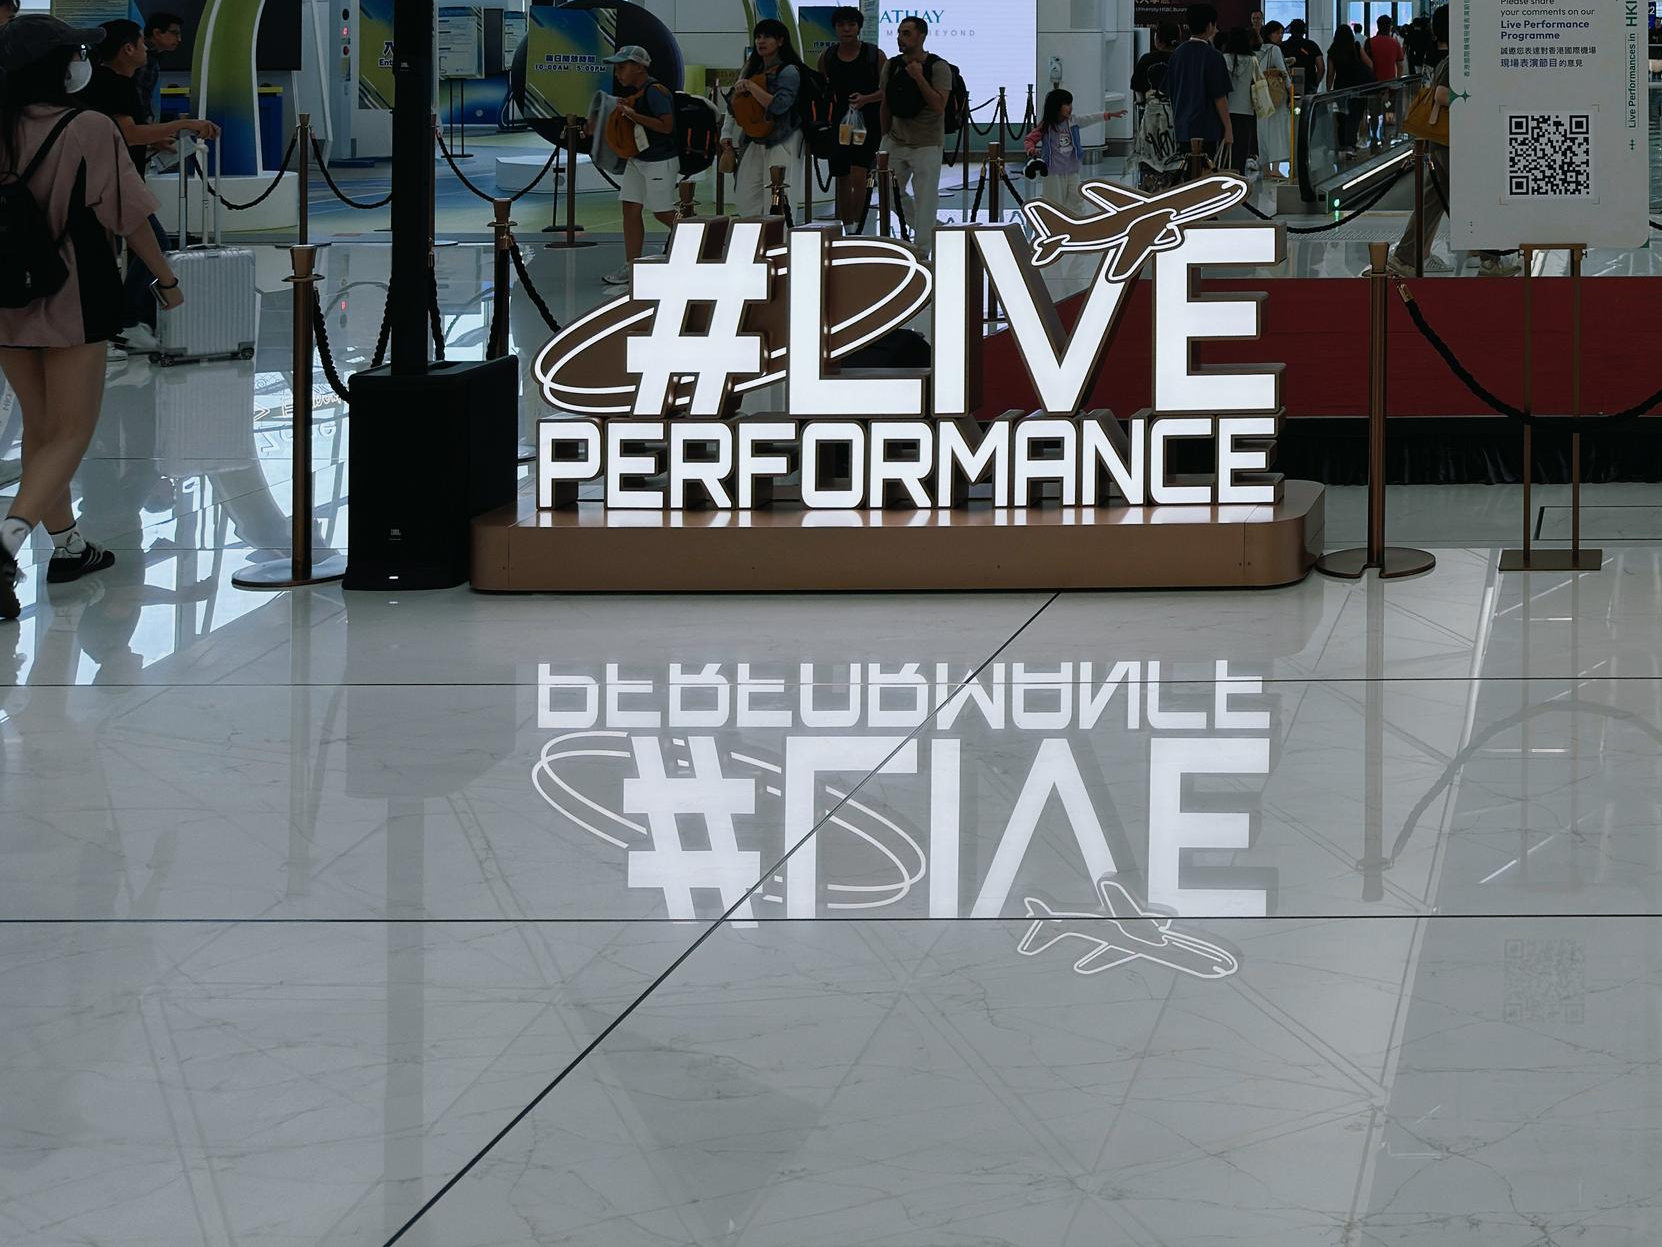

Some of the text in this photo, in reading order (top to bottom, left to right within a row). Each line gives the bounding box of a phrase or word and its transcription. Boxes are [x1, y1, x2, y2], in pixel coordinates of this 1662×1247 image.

[1500, 9, 1519, 17] your
[1521, 8, 1566, 16] comments
[1500, 19, 1590, 29] Live Performance
[1500, 31, 1560, 41] Programme
[1628, 33, 1637, 42] in
[1500, 58, 1583, 68] 現場表演節目的意見
[1628, 43, 1637, 106] Performances
[1628, 107, 1637, 128] Live
[626, 221, 1277, 416] #LIVE
[537, 417, 1277, 510] PERFORMANCE
